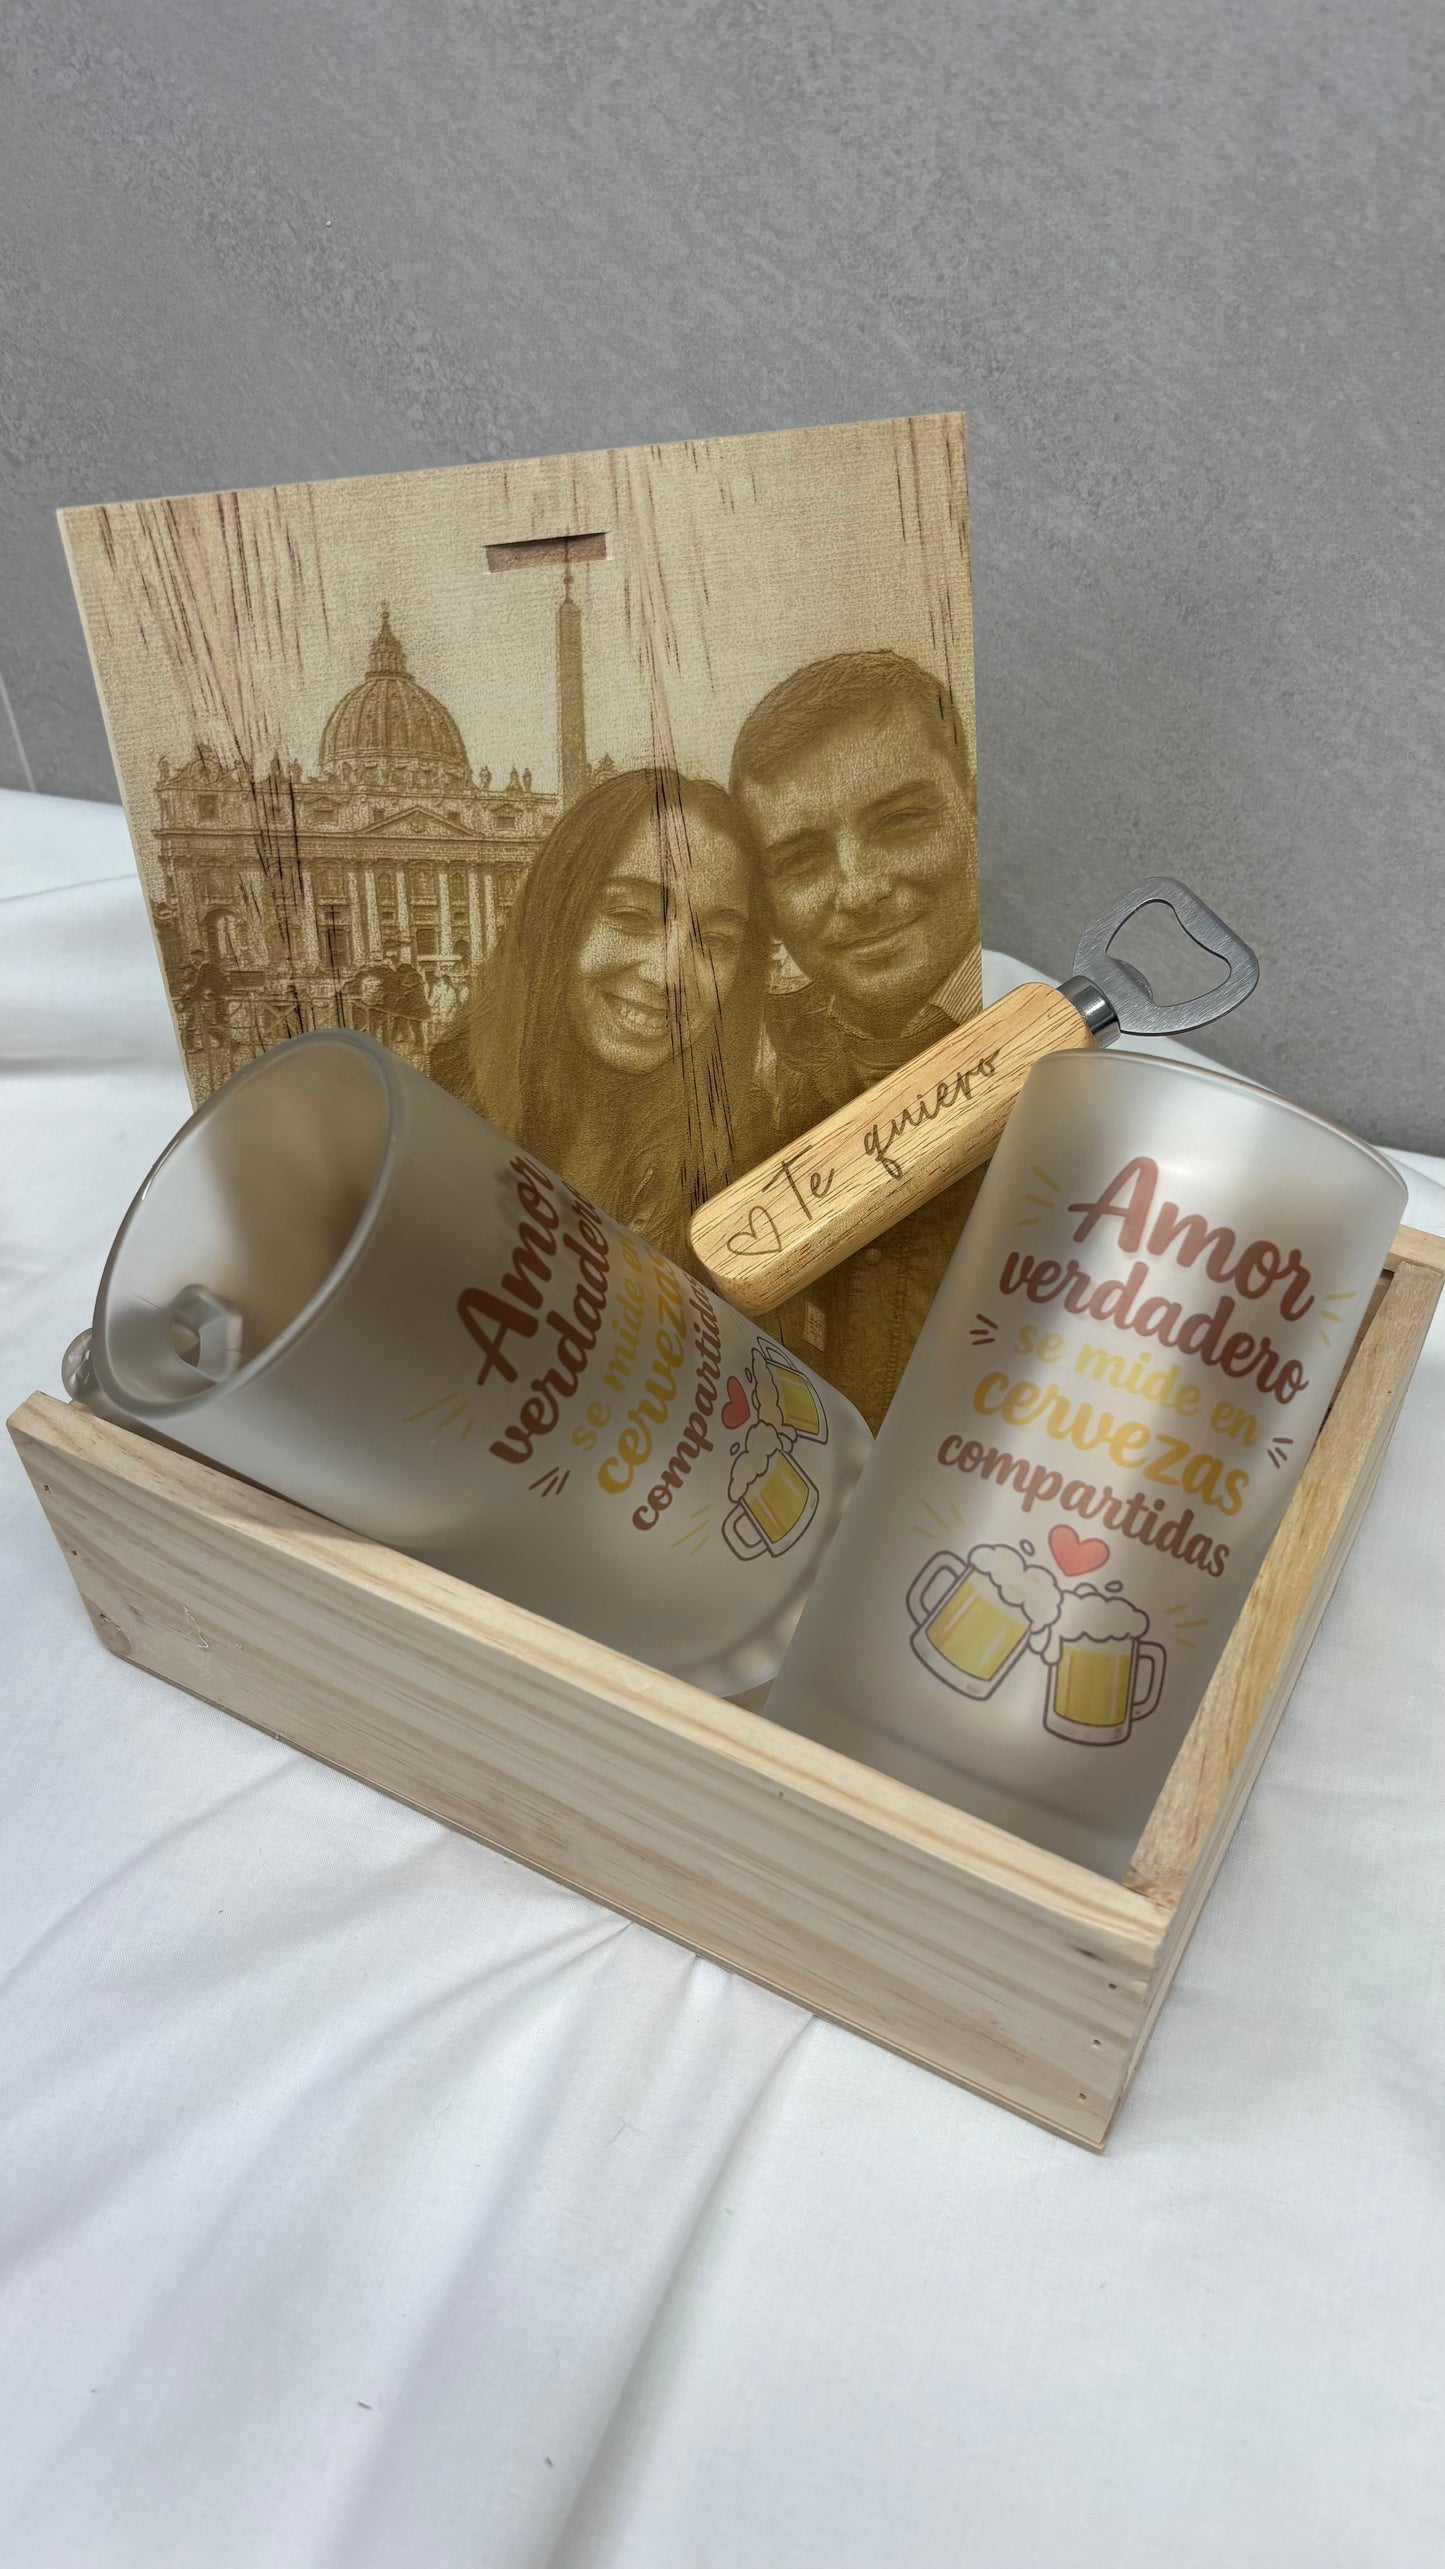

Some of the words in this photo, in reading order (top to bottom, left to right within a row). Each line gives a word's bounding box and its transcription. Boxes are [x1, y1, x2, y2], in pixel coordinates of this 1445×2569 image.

[762, 1144, 836, 1221] Te
[863, 1049, 1001, 1180] quiero
[456, 1155, 560, 1386] Amor
[1067, 1156, 1315, 1322] Amor
[571, 1401, 612, 1452] se
[602, 1277, 645, 1393] mide
[999, 1251, 1309, 1404] verdadero
[1012, 1323, 1066, 1364] se
[1073, 1341, 1202, 1418] mide
[1208, 1399, 1260, 1448] en
[937, 1434, 1230, 1578] compartidas
[972, 1370, 1250, 1516] cervezas
